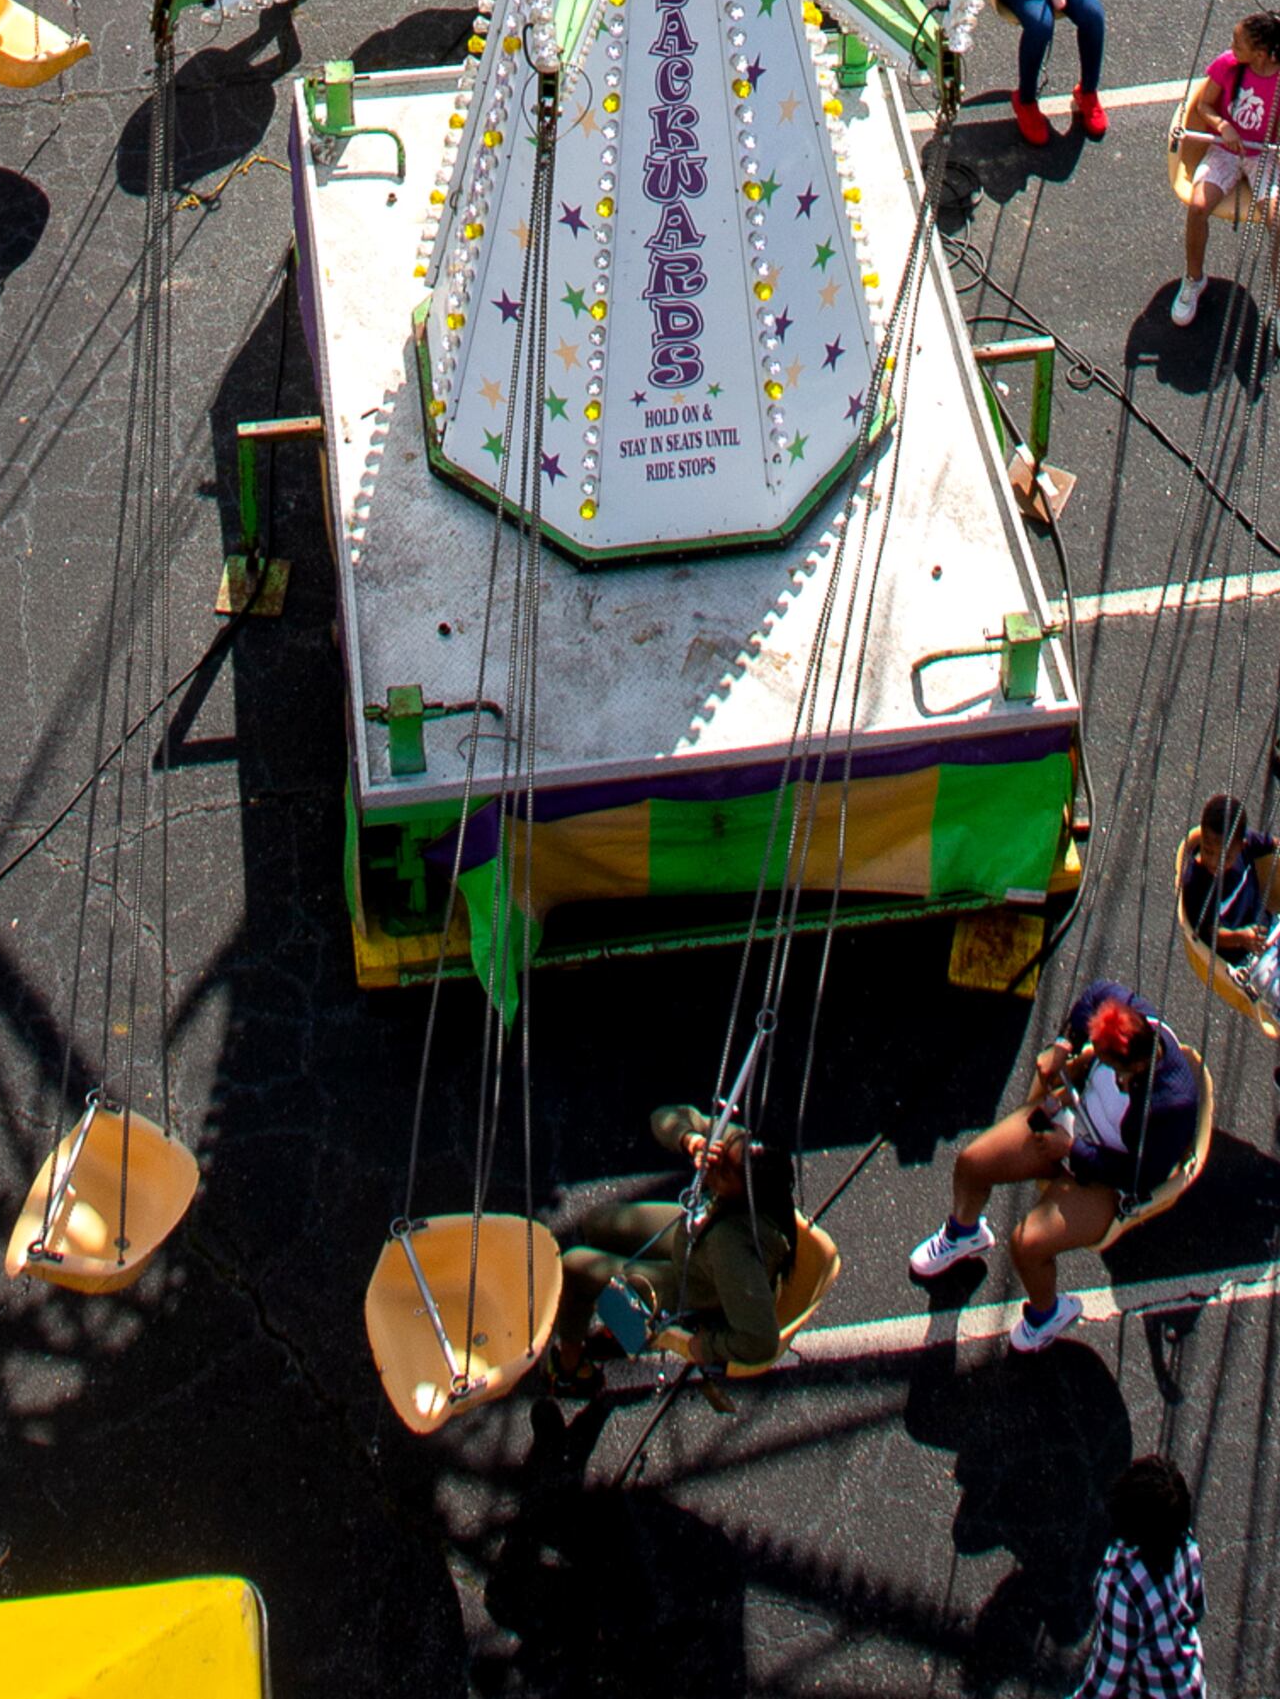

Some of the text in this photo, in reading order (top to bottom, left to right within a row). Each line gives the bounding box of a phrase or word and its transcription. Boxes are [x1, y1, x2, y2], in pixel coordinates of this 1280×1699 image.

[644, 403, 713, 428] HOLD ON &
[619, 428, 741, 458] STAY IN SEATS UNTIL
[646, 456, 716, 482] RIDE STOPS
